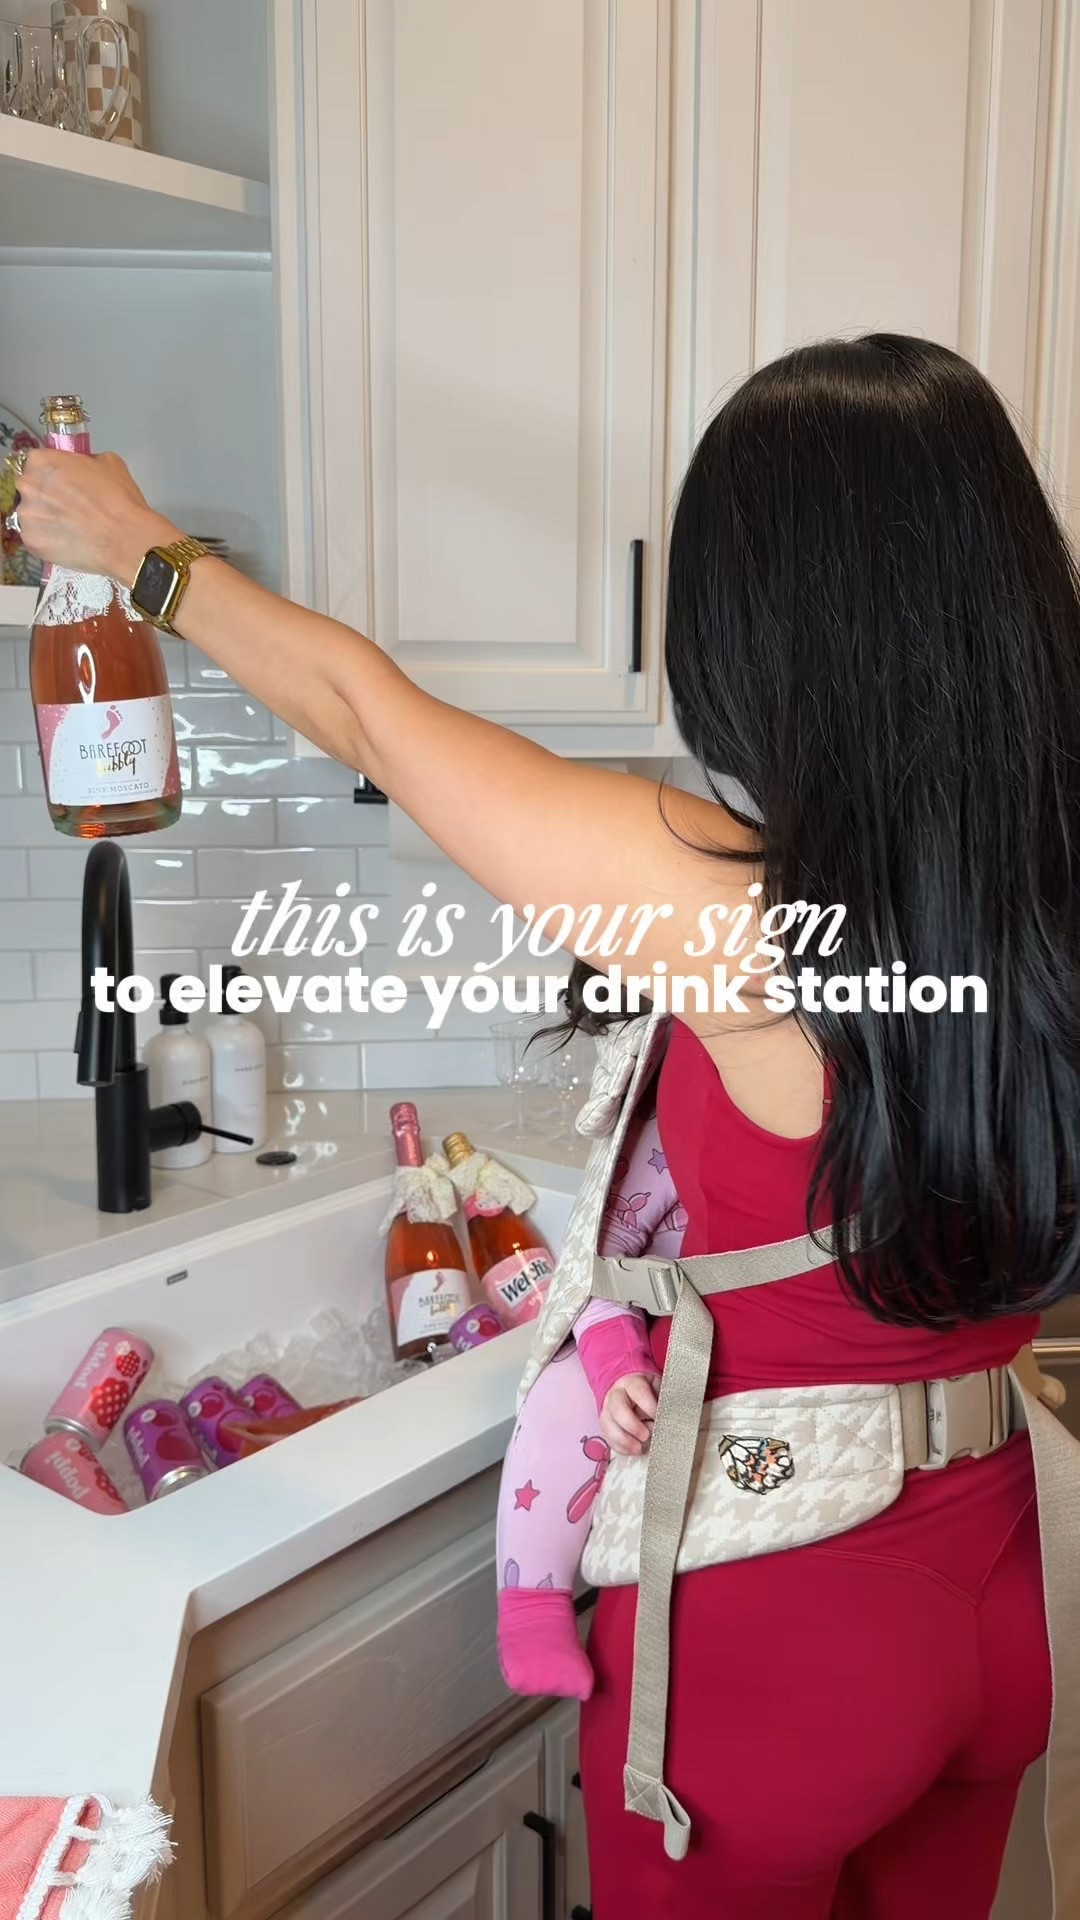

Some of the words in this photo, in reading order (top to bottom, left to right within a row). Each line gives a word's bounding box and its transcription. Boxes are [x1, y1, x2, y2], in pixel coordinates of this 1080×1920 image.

[79, 739, 147, 760] BAREFOOT
[99, 751, 136, 776] ubbly
[110, 782, 150, 793] MOSCATO
[44, 1451, 91, 1499] poppi
